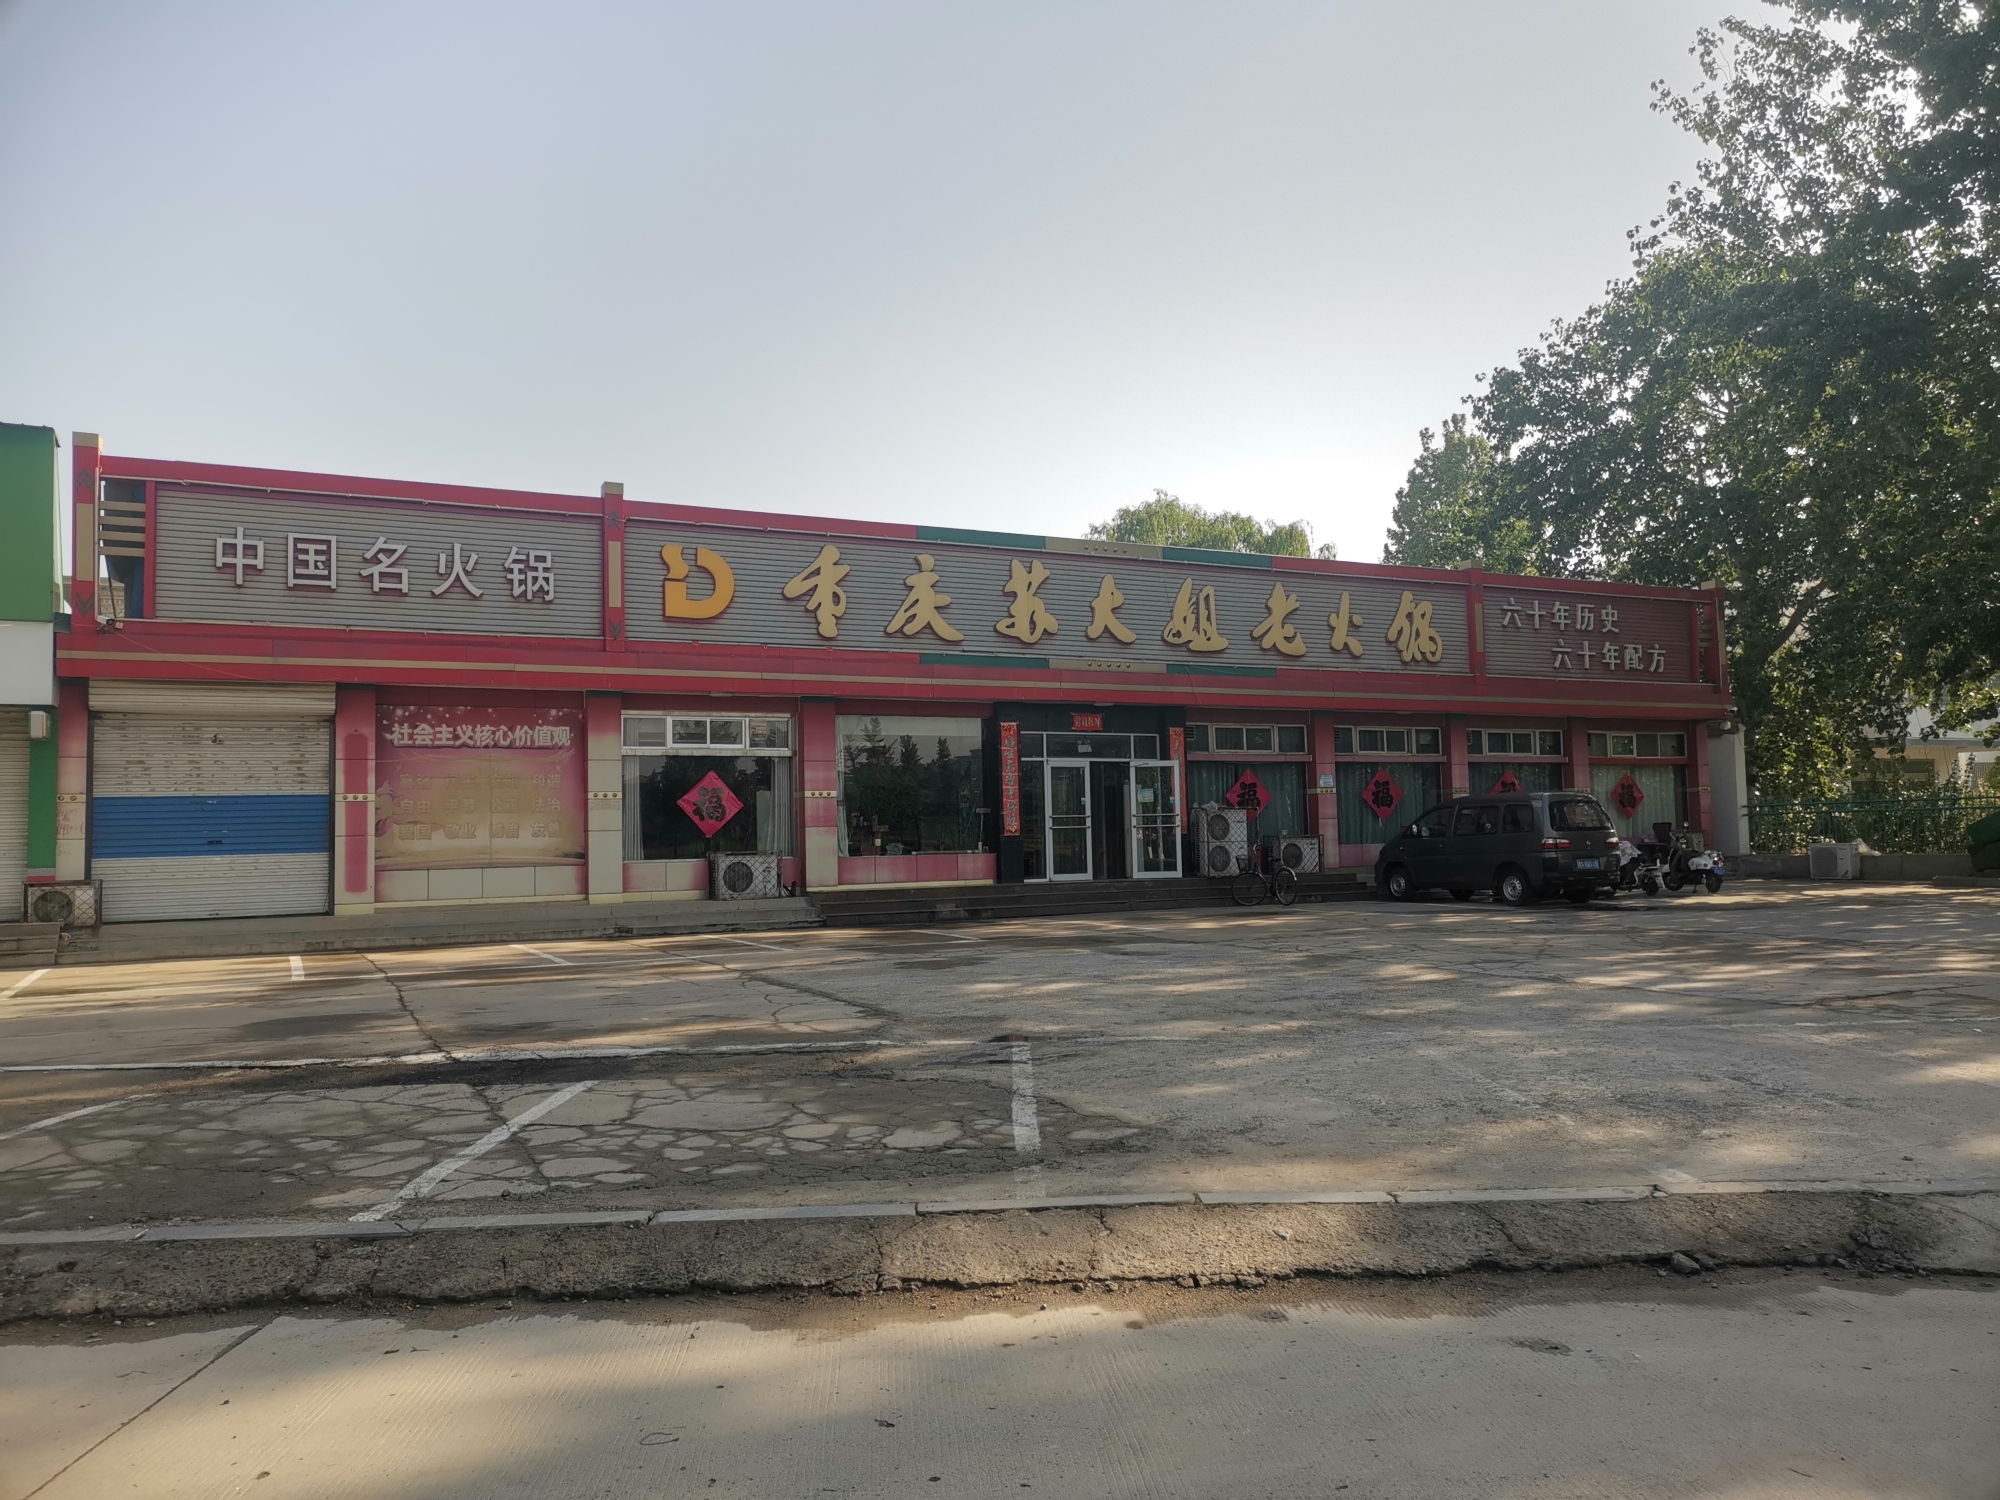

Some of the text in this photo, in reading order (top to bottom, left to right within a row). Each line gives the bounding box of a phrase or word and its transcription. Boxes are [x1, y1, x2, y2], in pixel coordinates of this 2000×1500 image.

[215, 526, 555, 602] 中国名火锅
[782, 543, 1444, 664] 重庆苏大姐老火锅
[1501, 597, 1620, 633] 六十年历史
[1551, 639, 1667, 673] 六十年配方
[391, 723, 571, 748] 社会主义核心价值观
[532, 773, 561, 789] 和谐
[1371, 780, 1393, 808] 福
[400, 798, 561, 814] 自由 平等 公正 法治
[692, 786, 727, 822] 福
[1237, 781, 1261, 811] 福
[1619, 783, 1637, 809] 福
[398, 824, 432, 840] 爱国
[444, 823, 477, 839] 敬业
[531, 821, 561, 838] 友善
